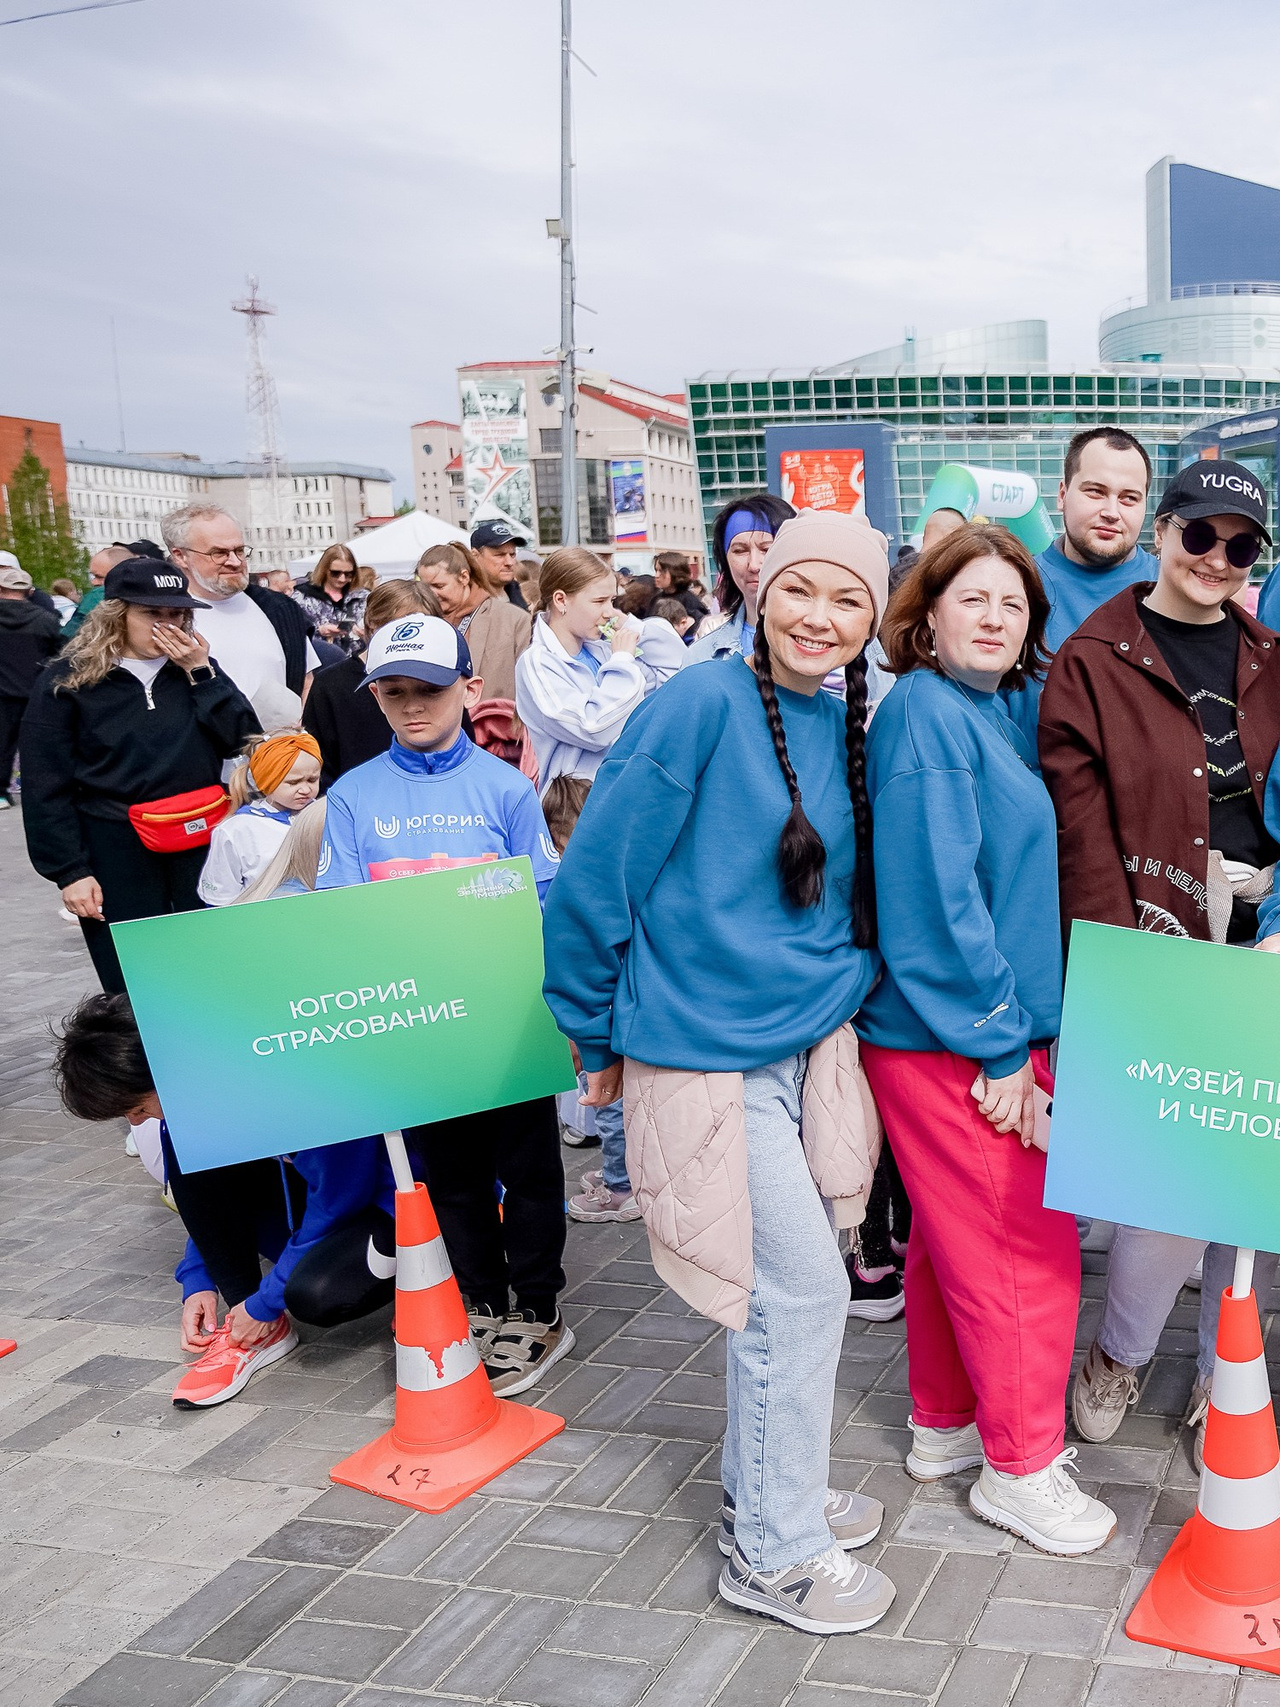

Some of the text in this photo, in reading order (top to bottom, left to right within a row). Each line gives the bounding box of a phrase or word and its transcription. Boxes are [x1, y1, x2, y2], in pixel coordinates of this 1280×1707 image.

[992, 483, 1024, 504] СТАРТ
[1200, 473, 1263, 507] YUGRA
[153, 575, 183, 588] МОГУ
[385, 643, 424, 654] Ночная
[406, 814, 485, 830] ЮГОРИЯ
[407, 828, 465, 837] СТРАХОВАНИЕ
[1143, 858, 1162, 877] И
[289, 978, 418, 1020] ЮГОРИЯ
[252, 998, 468, 1056] СТРАХОВАНИЕ
[1125, 1059, 1244, 1098] «МУЗЕЙ
[1158, 1098, 1181, 1122] И
